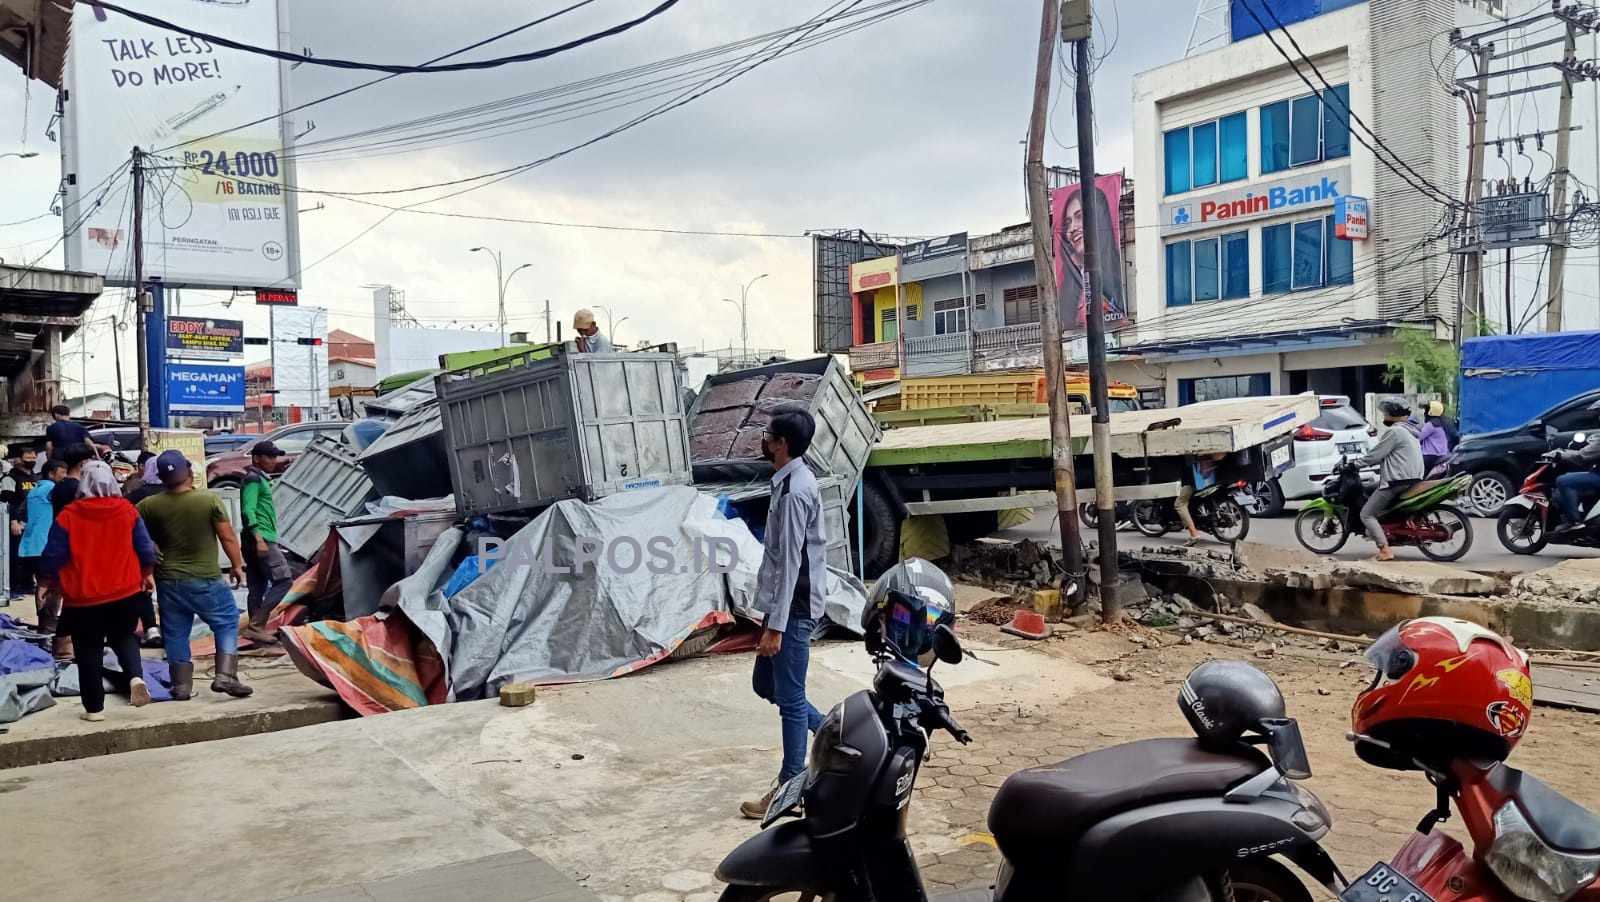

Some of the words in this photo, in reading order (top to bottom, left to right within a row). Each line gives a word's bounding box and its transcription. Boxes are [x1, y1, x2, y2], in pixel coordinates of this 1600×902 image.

[102, 38, 158, 61] TALK
[165, 36, 213, 56] LESS
[111, 68, 143, 87] DO
[153, 58, 222, 85] MORE!
[200, 149, 279, 178] 24.000
[215, 180, 235, 195] /16
[237, 181, 281, 196] BATANG
[1200, 176, 1339, 223] PaninBank
[1346, 213, 1366, 225] Panin
[265, 246, 281, 255] 18+
[170, 320, 205, 335] EDDY
[619, 463, 628, 478] 2
[1366, 867, 1399, 895] BC
